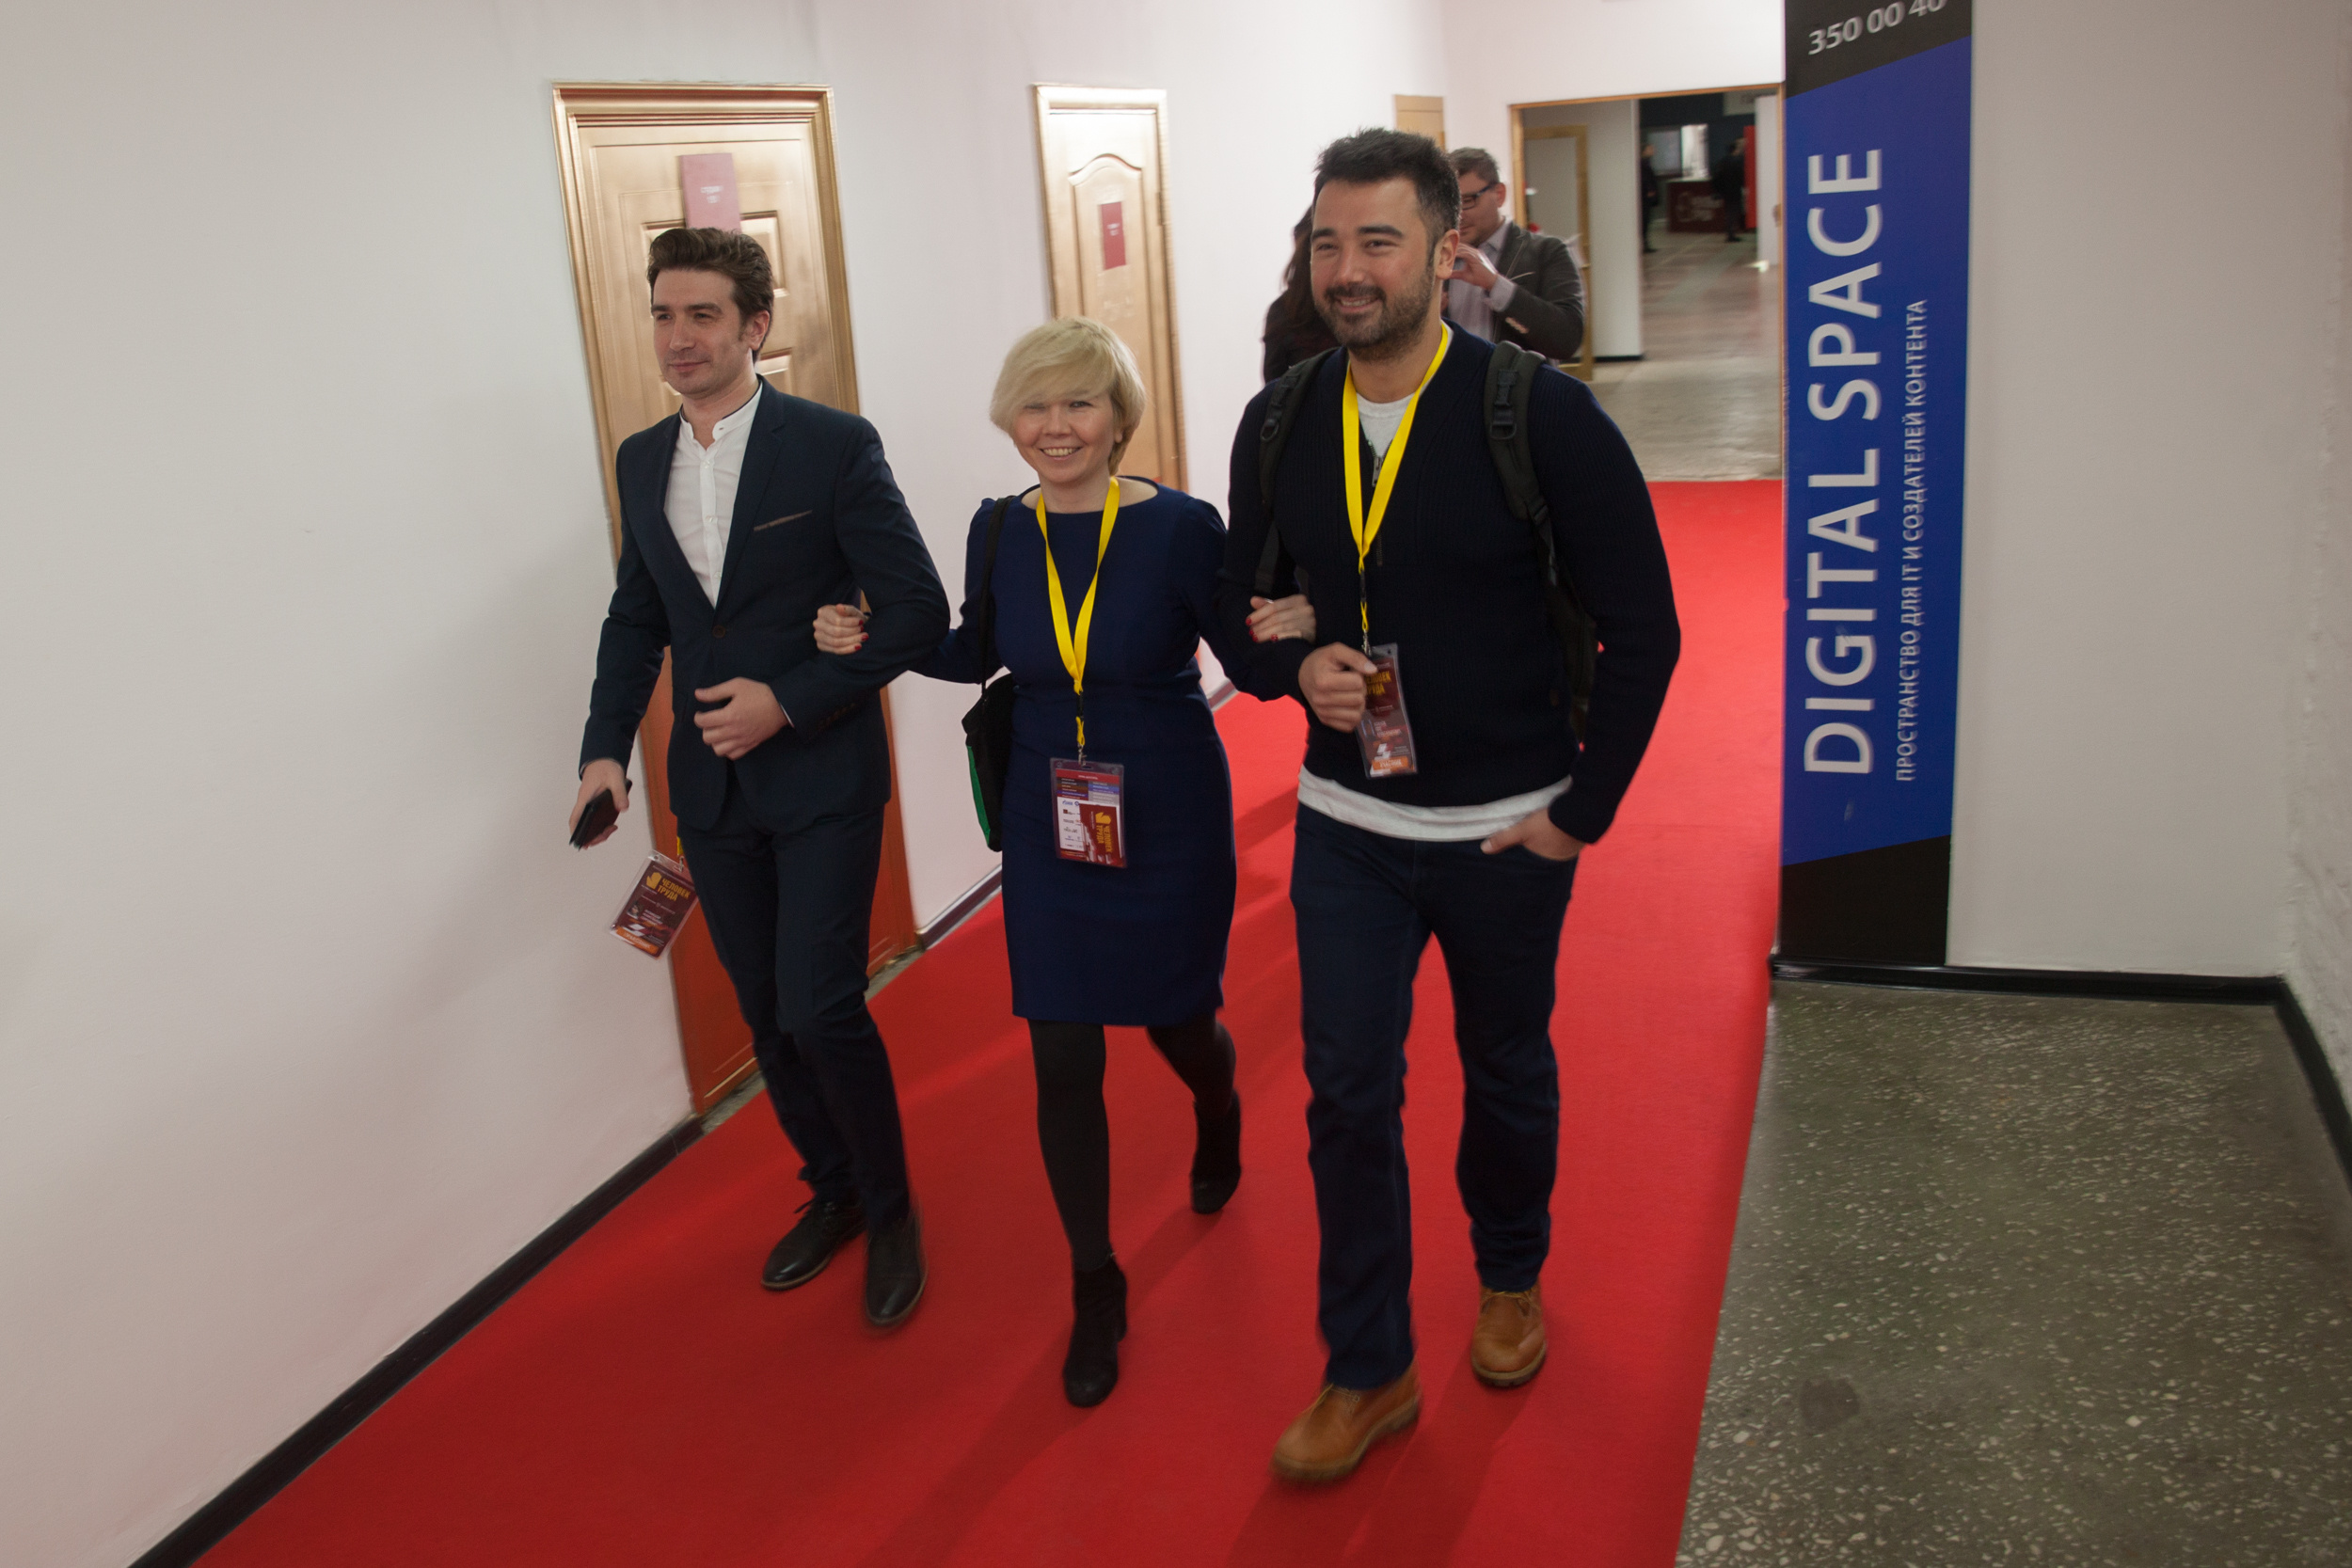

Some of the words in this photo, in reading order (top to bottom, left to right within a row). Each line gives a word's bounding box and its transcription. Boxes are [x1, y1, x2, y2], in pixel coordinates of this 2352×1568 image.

[1808, 17, 1862, 55] 350
[1867, 2, 1904, 34] 00
[1807, 149, 1882, 420] SPACE
[1904, 300, 1928, 406] КОНТЕНТА
[1901, 411, 1928, 542] СОЗДАТЕЛЕЙ
[1901, 546, 1923, 560] И
[1902, 563, 1923, 581] IT
[1804, 448, 1881, 774] DIGITAL
[1899, 587, 1923, 626] ДЛЯ
[1367, 682, 1386, 696] РУДА
[1896, 632, 1920, 782] ПРОСТРАНСТВО
[658, 885, 678, 901] ТРУДА
[661, 878, 691, 899] ЧЕЛОВЕК
